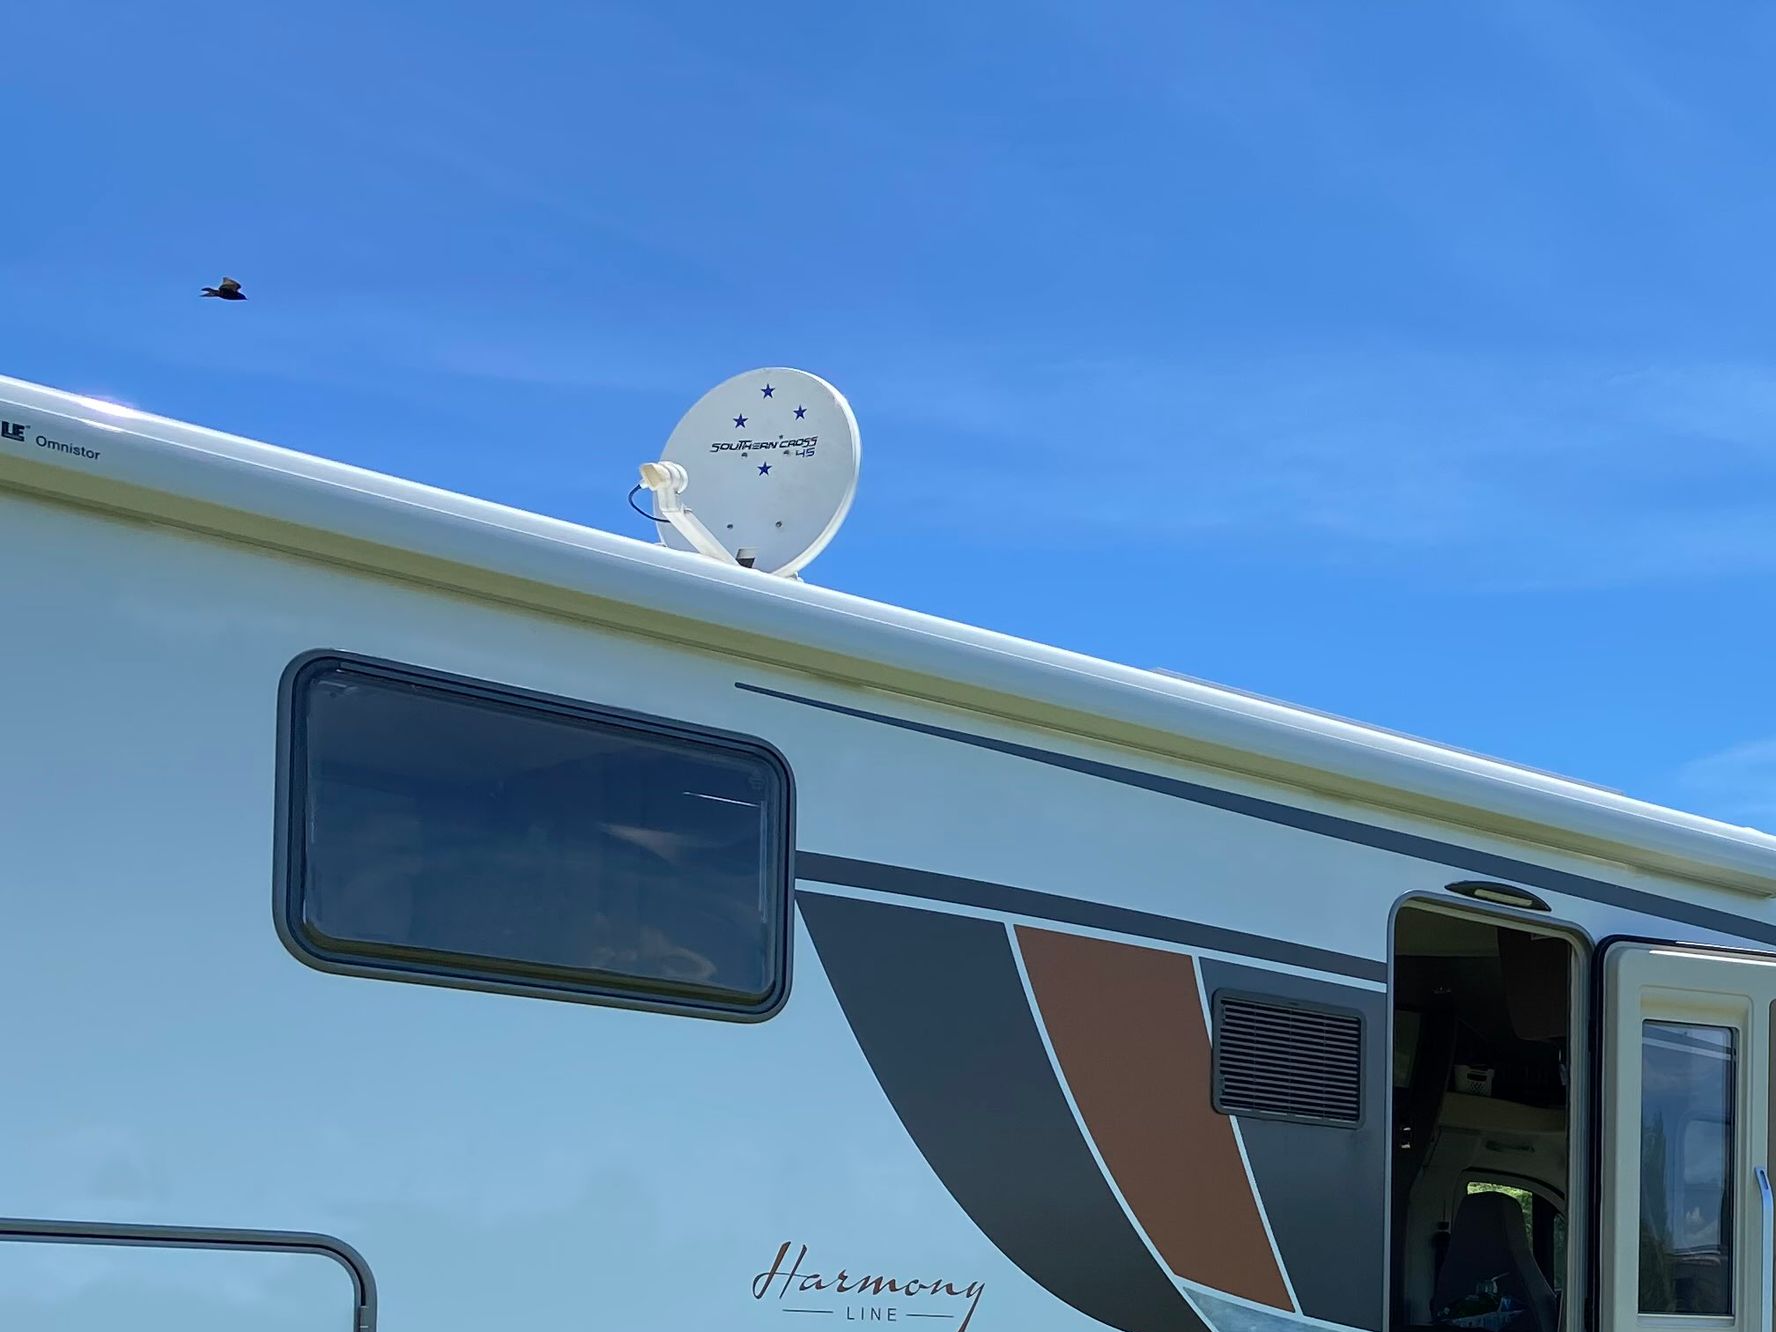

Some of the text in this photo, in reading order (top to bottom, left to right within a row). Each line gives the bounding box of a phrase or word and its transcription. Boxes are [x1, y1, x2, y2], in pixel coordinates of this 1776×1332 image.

[35, 435, 101, 460] Omnistor
[710, 436, 818, 453] SOUTHERN CROSS
[795, 447, 816, 457] 45
[846, 1306, 897, 1322] LINE
